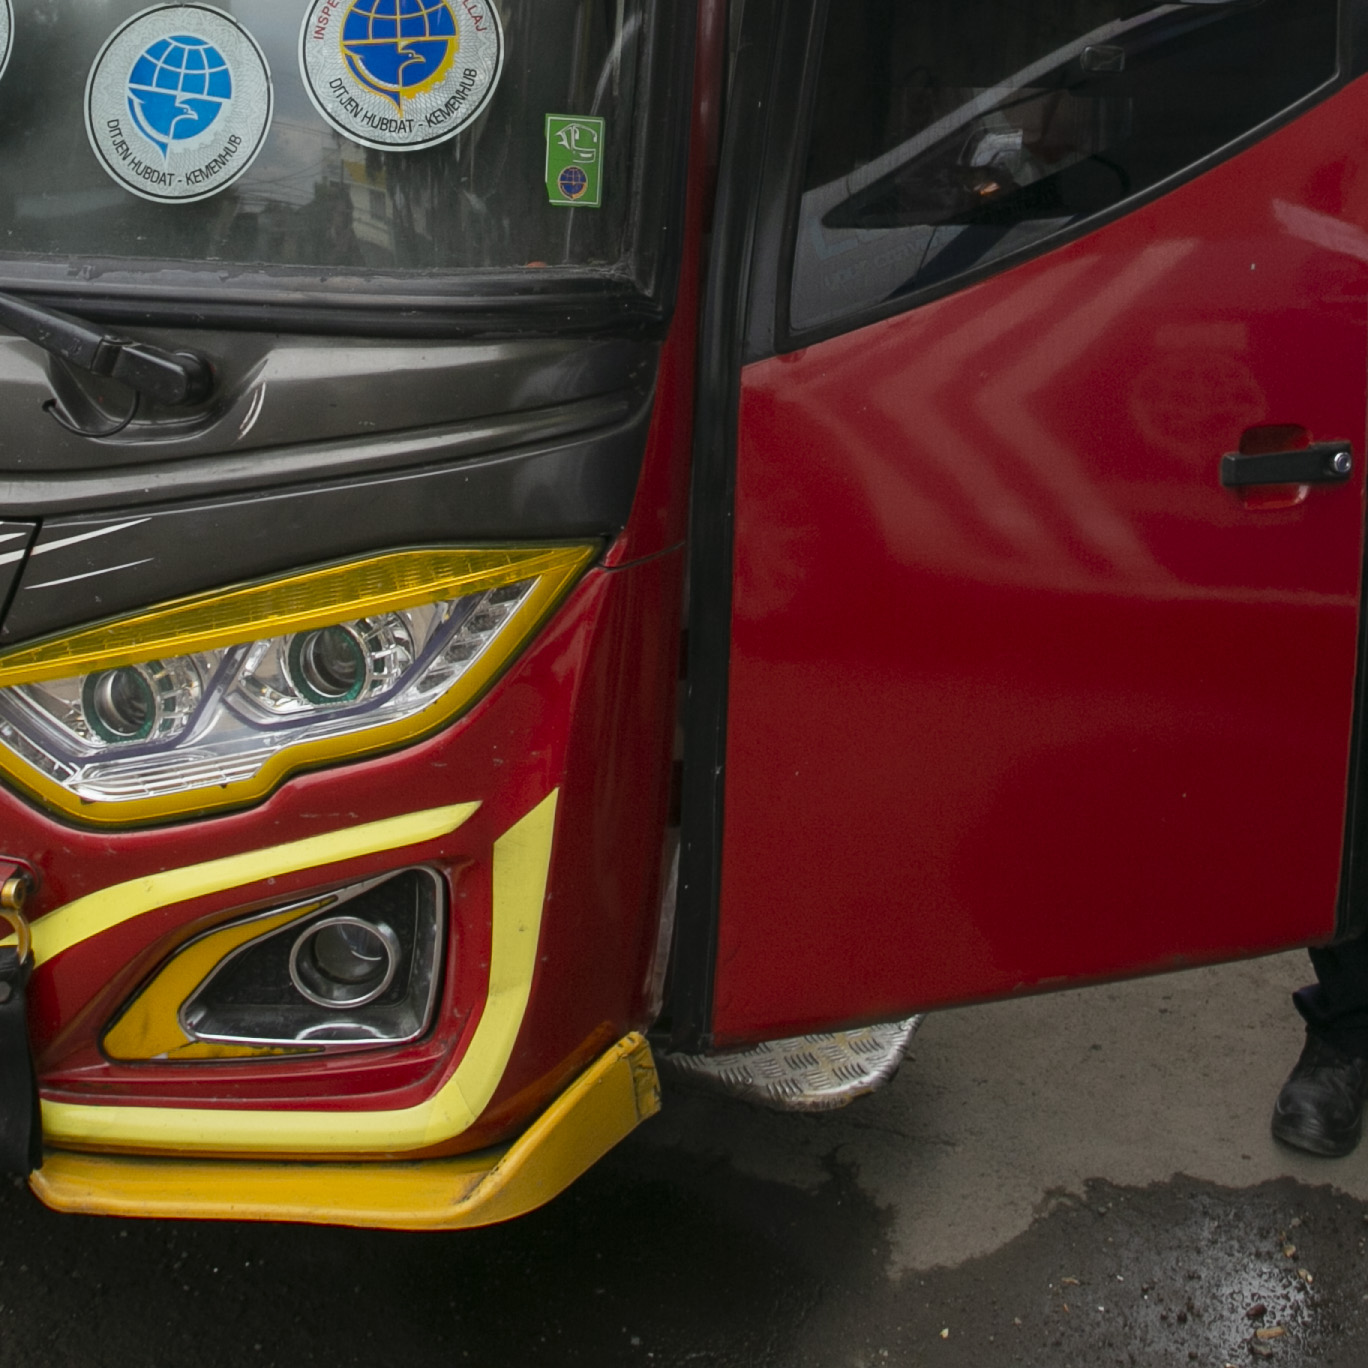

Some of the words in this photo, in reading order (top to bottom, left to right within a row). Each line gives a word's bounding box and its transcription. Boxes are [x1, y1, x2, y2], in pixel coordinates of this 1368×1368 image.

[329, 77, 363, 119] DITJEN
[361, 110, 414, 134] HUBDAT
[425, 68, 477, 129] KEMENHUB
[107, 118, 132, 161] DITJEN
[130, 155, 175, 187] HUBDAT
[185, 133, 243, 186] KEMENHUB
